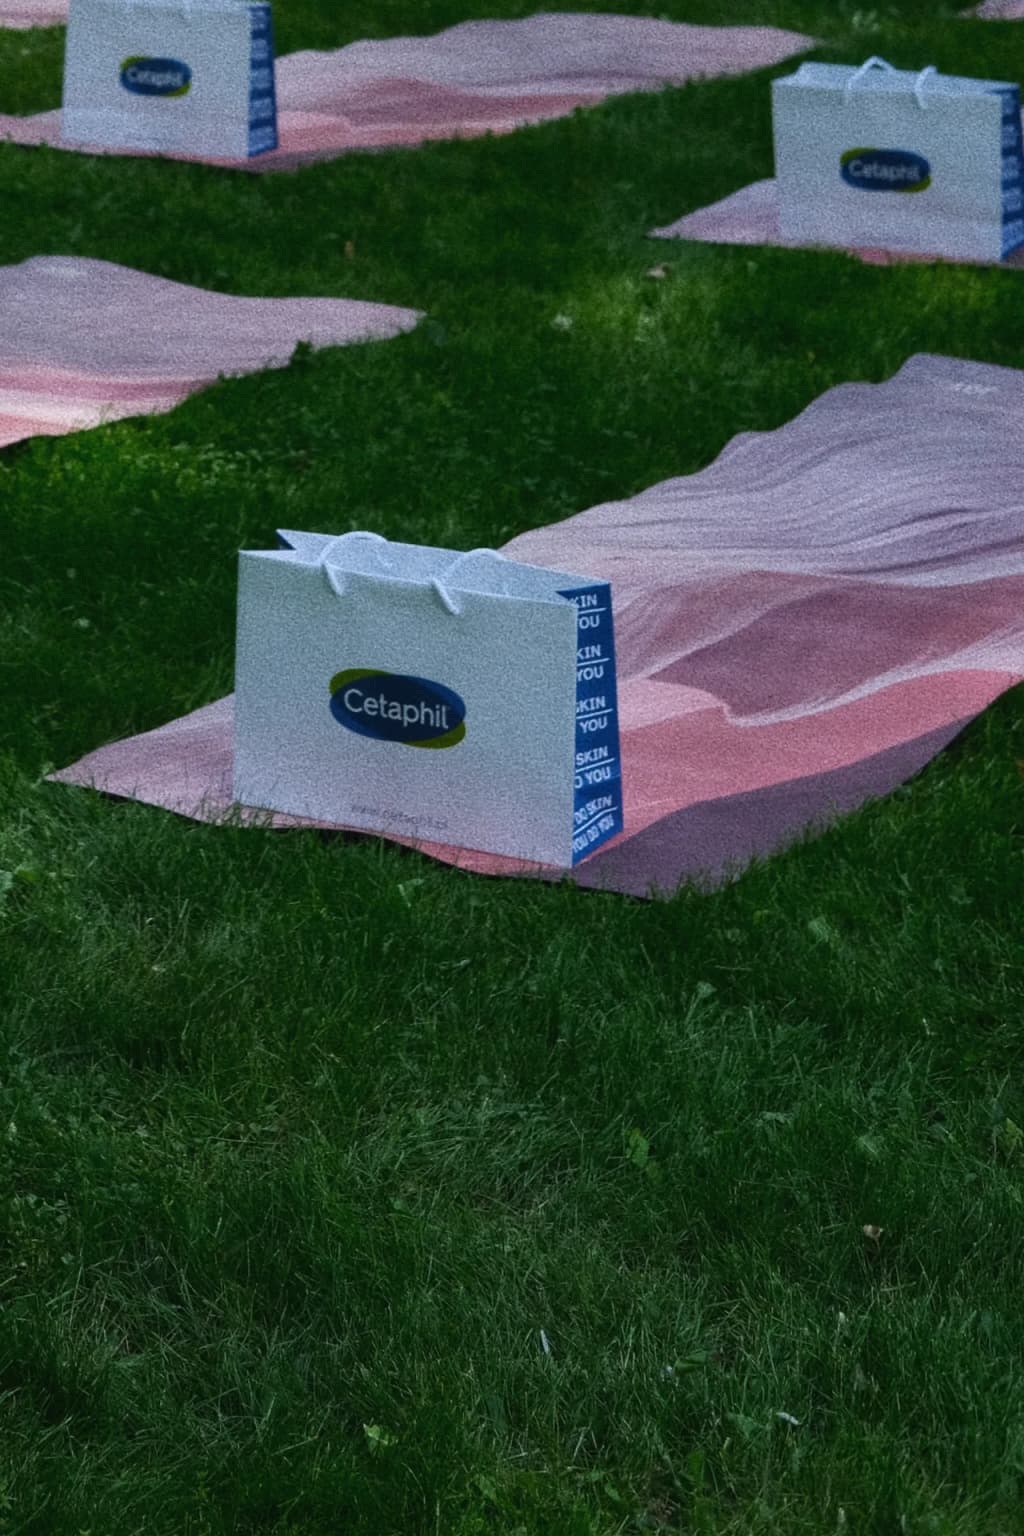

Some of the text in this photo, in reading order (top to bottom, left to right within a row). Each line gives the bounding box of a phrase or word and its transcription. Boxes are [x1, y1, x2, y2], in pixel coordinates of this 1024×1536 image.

[577, 615, 600, 630] OU
[576, 644, 602, 660] KIN
[343, 688, 449, 730] Cetaphil
[579, 716, 608, 734] YOU
[576, 744, 608, 766] SKIN
[585, 766, 612, 785] YOU
[587, 794, 613, 816] SKIN
